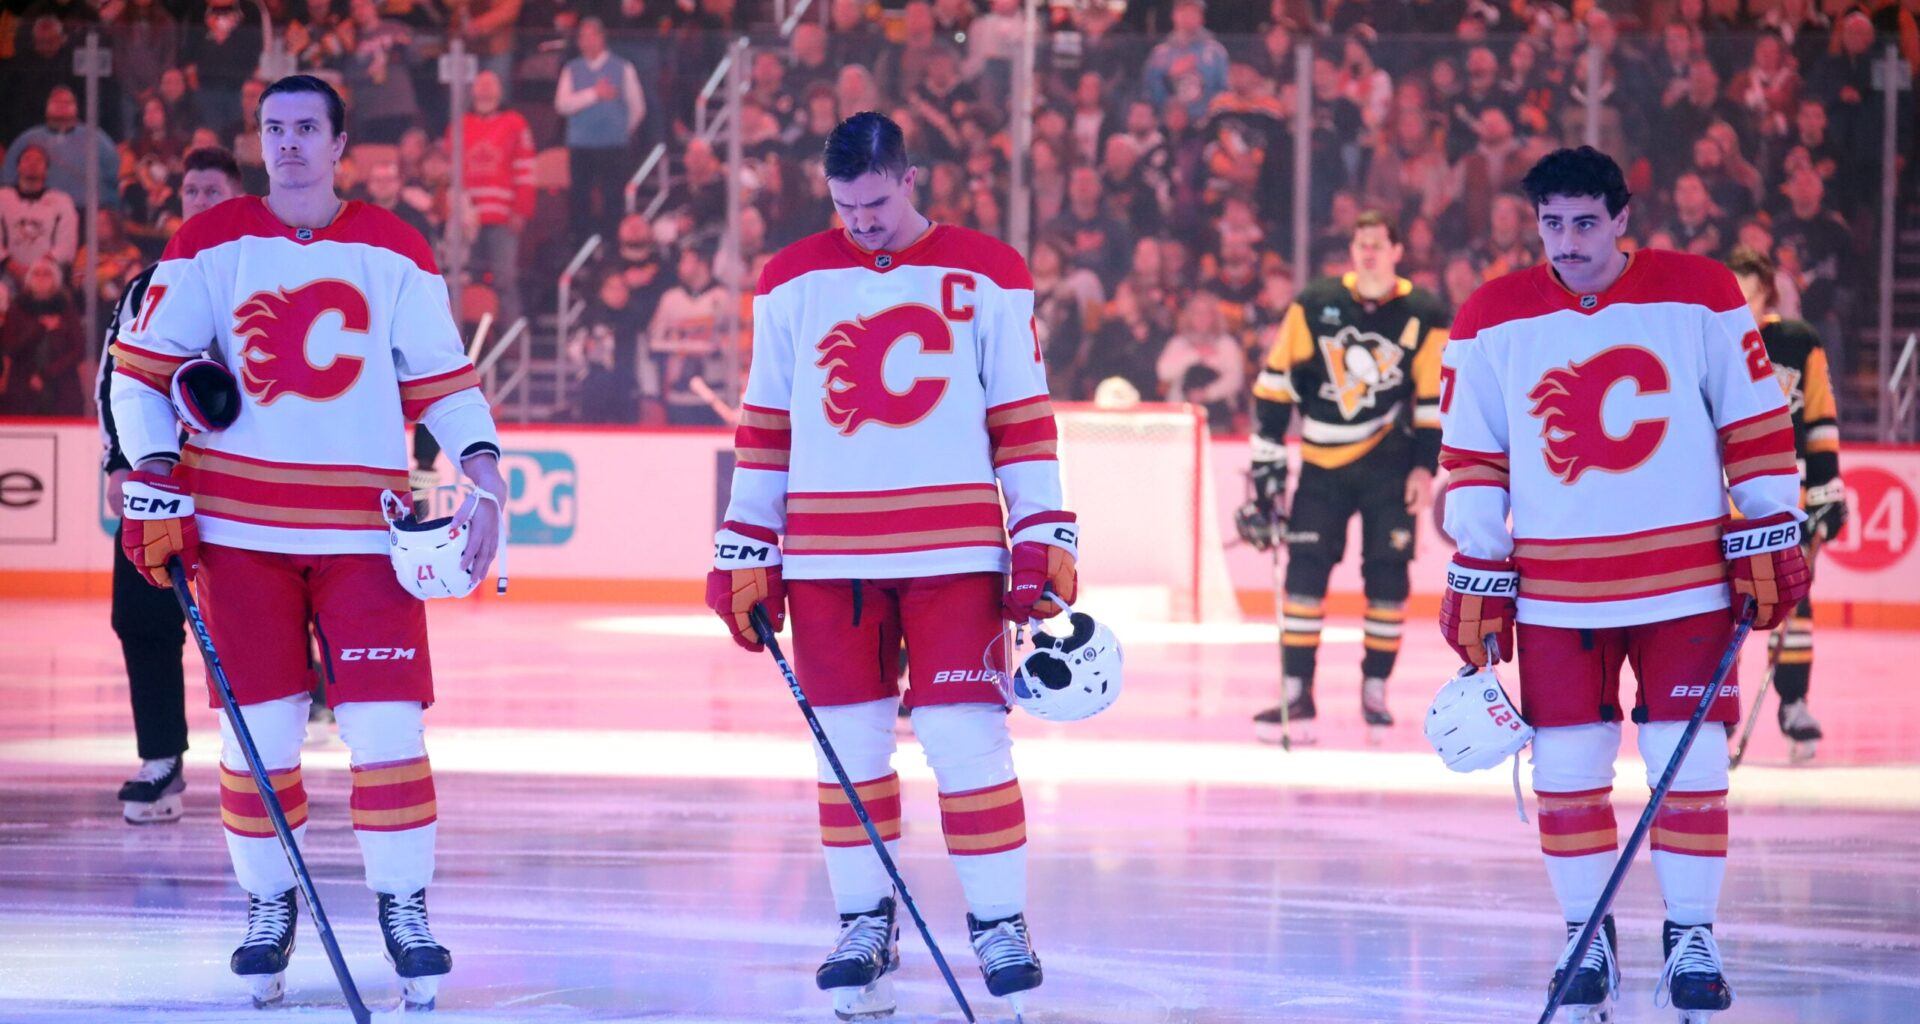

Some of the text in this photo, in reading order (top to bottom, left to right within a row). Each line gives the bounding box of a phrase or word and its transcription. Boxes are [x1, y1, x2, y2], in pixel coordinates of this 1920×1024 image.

[940, 272, 977, 322] C
[1741, 329, 1775, 383] 2
[0, 471, 43, 508] e
[1054, 528, 1077, 545] C
[418, 565, 435, 580] 17
[1016, 583, 1037, 591] CCM
[189, 605, 216, 653] CCM
[340, 647, 416, 661] CCM
[777, 659, 806, 701] CCM
[1670, 684, 1739, 697] BAER
[1487, 703, 1513, 727] 27
